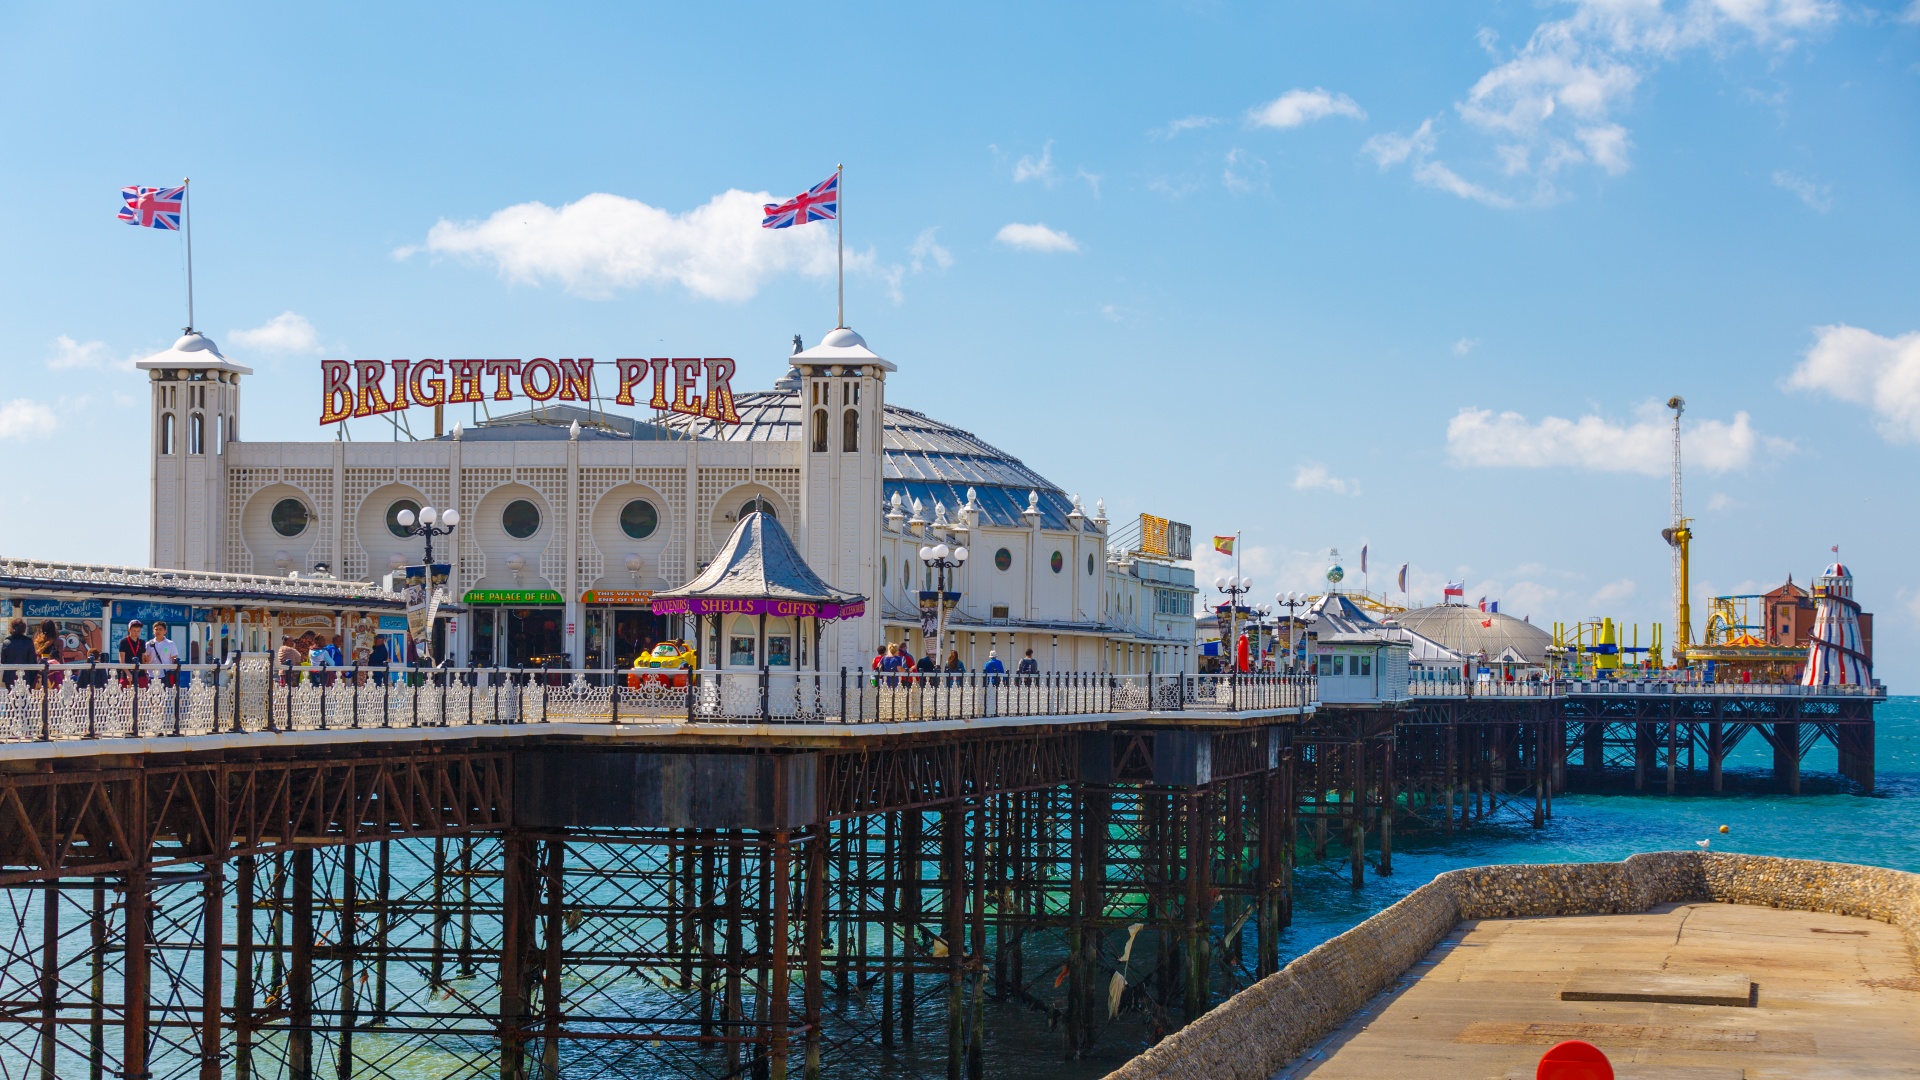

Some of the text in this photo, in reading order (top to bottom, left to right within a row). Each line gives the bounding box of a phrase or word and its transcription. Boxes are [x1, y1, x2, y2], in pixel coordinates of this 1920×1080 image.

[319, 357, 741, 426] BRIGHTON PIER
[469, 592, 557, 601] THE PALACE OF FUN
[26, 601, 62, 616] Seafood
[65, 600, 91, 615] Sushi
[652, 598, 687, 613] SOUVENIRS
[700, 600, 754, 612] SHELLS
[777, 602, 816, 615] GIFTS
[355, 624, 376, 634] LOVE
